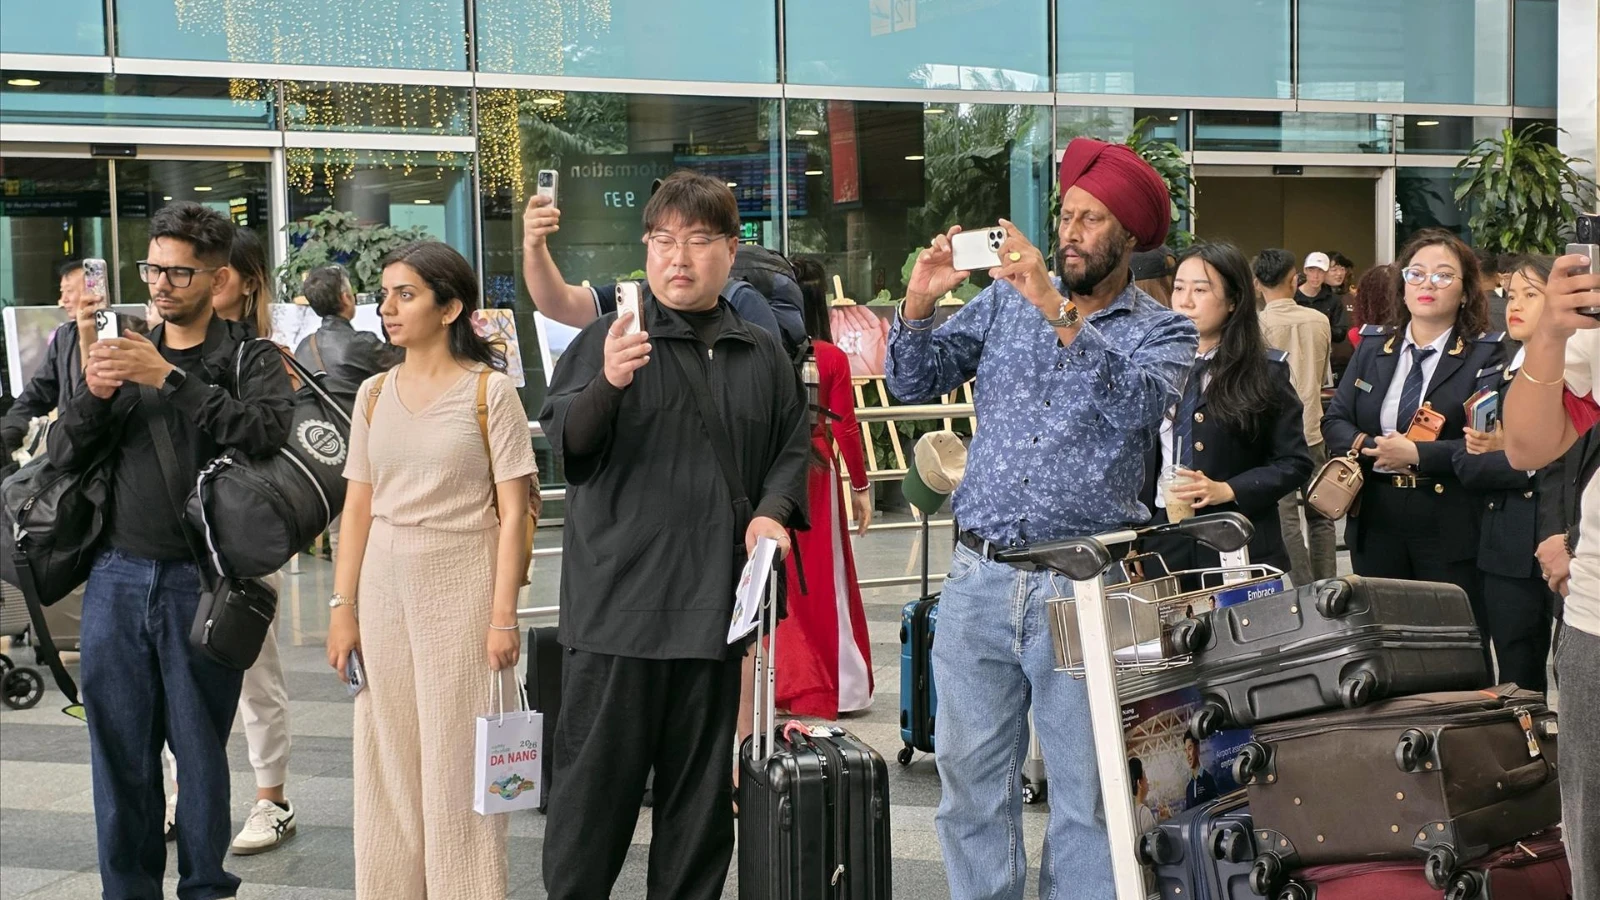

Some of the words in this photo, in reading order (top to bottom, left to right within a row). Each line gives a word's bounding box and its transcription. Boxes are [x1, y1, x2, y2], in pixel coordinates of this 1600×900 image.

[1247, 587, 1275, 601] Embrace
[520, 740, 537, 749] 2026
[490, 754, 505, 766] DA
[508, 749, 537, 764] NANG
